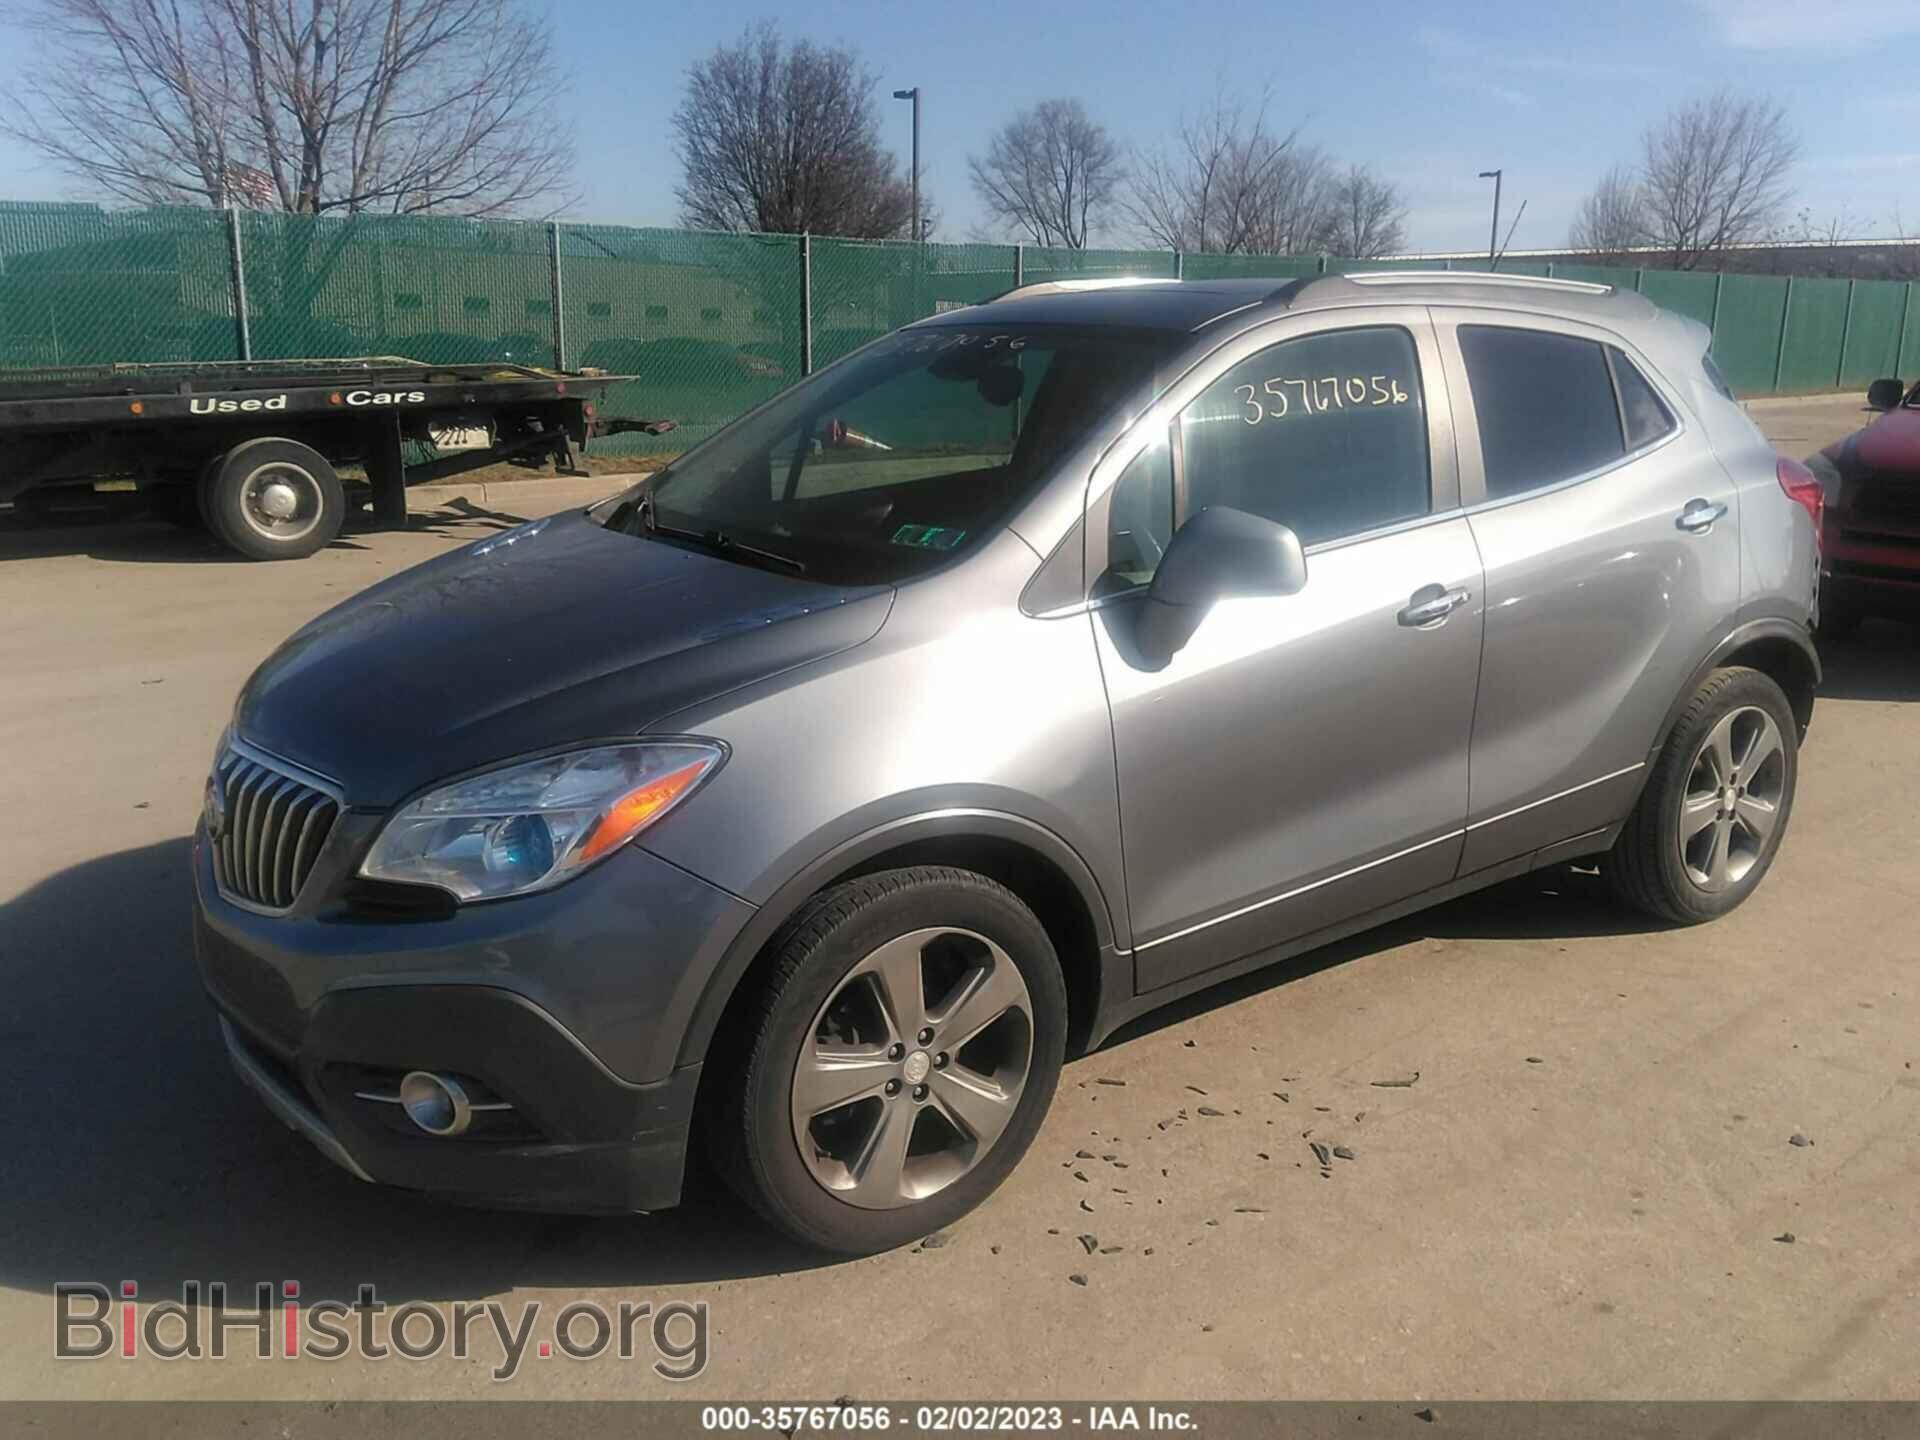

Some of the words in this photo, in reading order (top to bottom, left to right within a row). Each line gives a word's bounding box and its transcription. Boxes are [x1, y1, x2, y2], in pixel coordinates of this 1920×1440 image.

[189, 394, 288, 415] Used
[345, 389, 426, 407] Cars
[1234, 375, 1409, 425] 35767056
